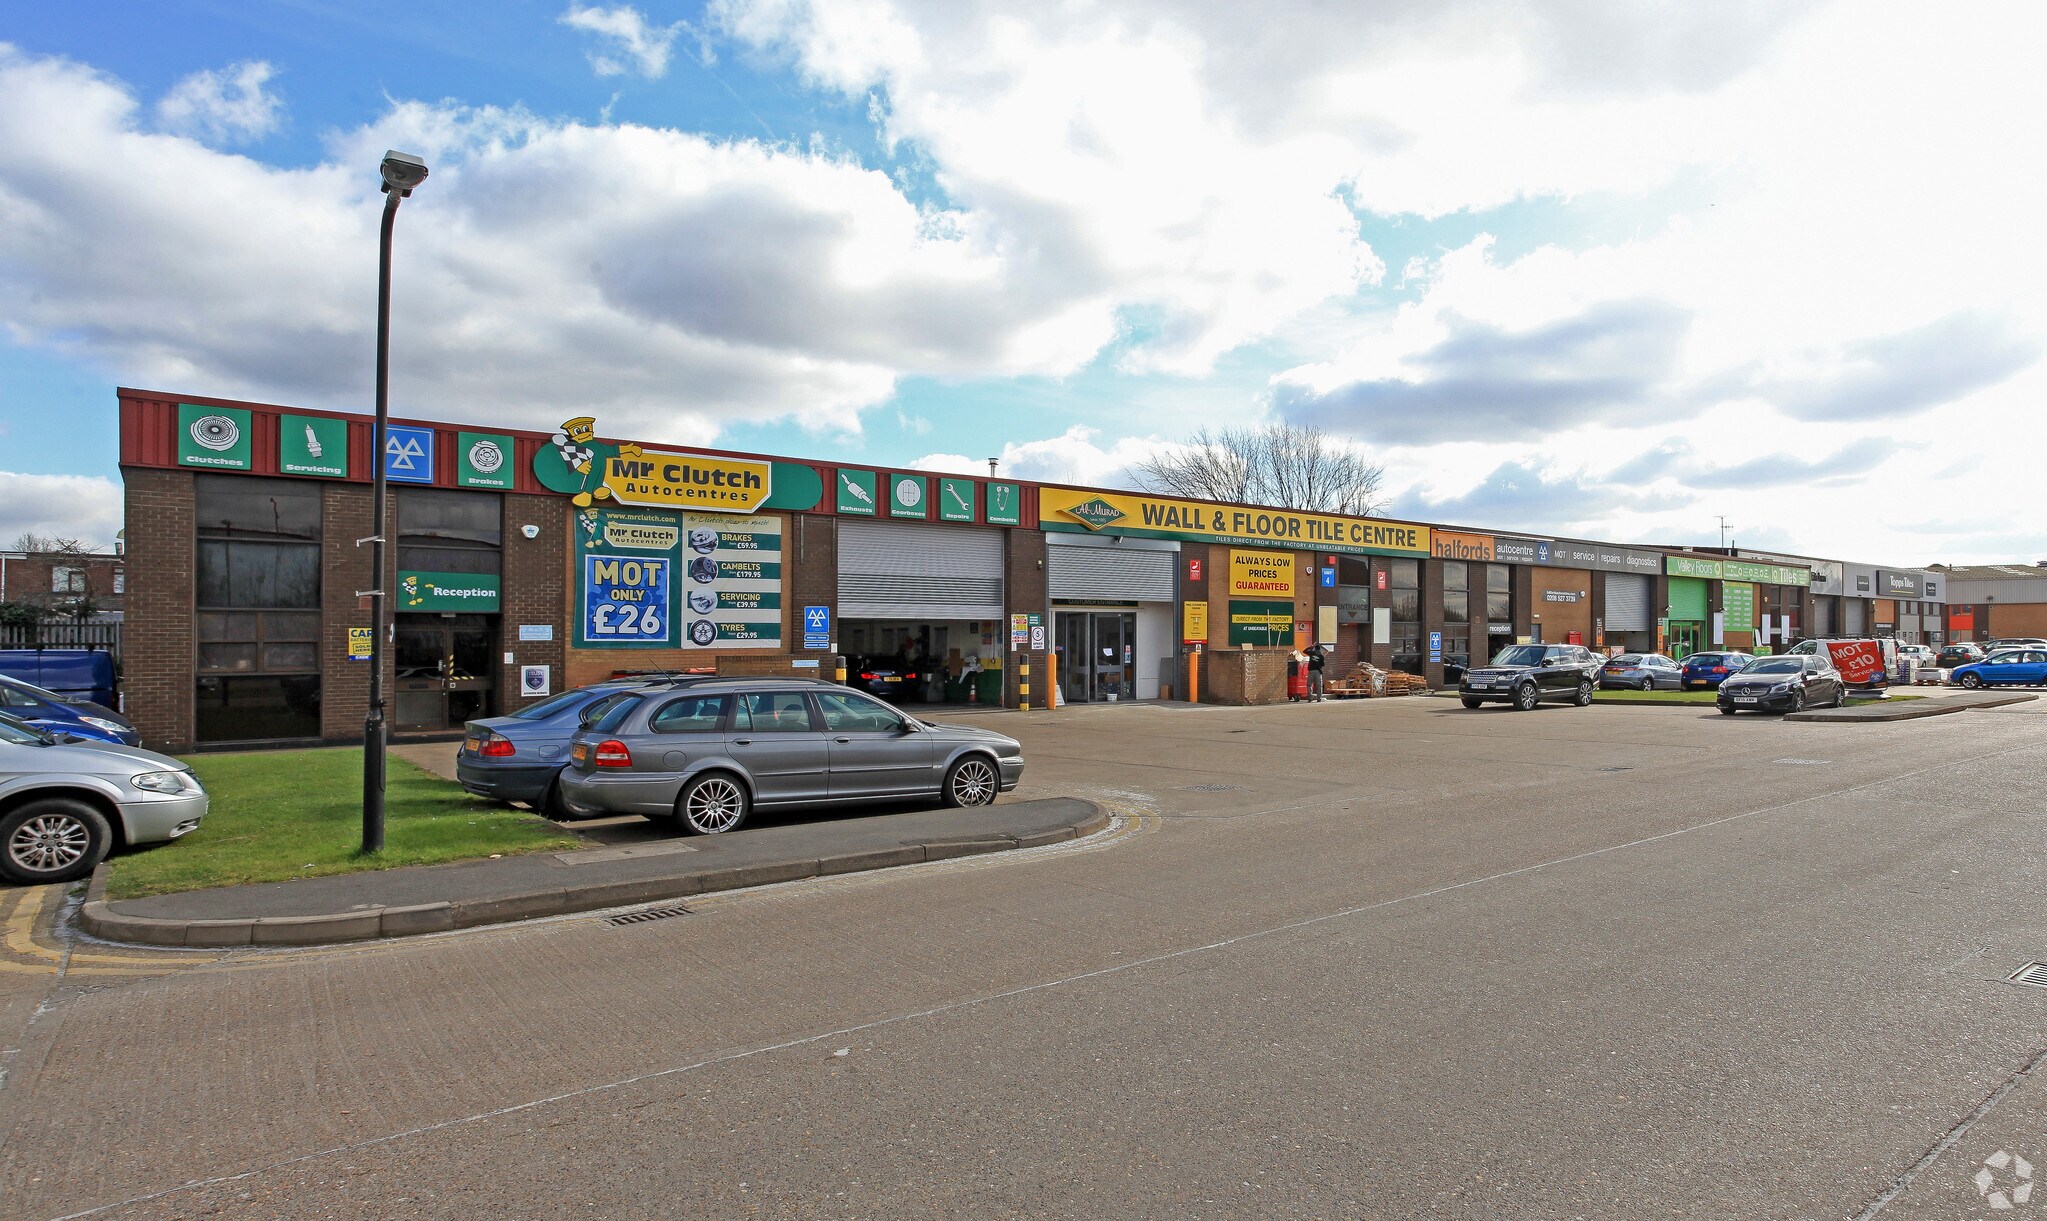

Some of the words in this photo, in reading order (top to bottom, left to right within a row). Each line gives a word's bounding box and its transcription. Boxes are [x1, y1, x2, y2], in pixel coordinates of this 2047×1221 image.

[186, 455, 244, 466] Clutches
[286, 464, 342, 475] Servicing
[612, 460, 654, 479] Mr
[663, 464, 761, 490] Clutch
[468, 477, 504, 486] Brakes
[625, 482, 749, 502] Autocentres
[606, 512, 676, 522] www.mrclutch.com
[1142, 503, 1205, 529] WALL
[1212, 510, 1226, 531] &
[1234, 512, 1300, 538] FLOOR
[1306, 520, 1344, 541] TILE
[1350, 524, 1416, 548] CENTRE
[631, 530, 673, 540] Clutch
[722, 534, 752, 542] BRAKES
[1436, 538, 1490, 560] halfords
[1496, 544, 1534, 556] autocentre
[1236, 556, 1270, 566] ALWAYS
[1272, 558, 1290, 567] LOW
[1554, 550, 1566, 558] MOT
[1573, 551, 1594, 560] service
[1600, 553, 1620, 564] repairs
[1626, 555, 1656, 568] diagnostics
[594, 560, 662, 587] MOT
[1248, 569, 1277, 578] PRICES
[1677, 560, 1694, 574] Valley
[1696, 561, 1712, 574] Floors
[1780, 568, 1796, 584] Tiles
[1890, 576, 1904, 588] Topps
[1904, 577, 1914, 588] Tiles
[433, 586, 496, 599] Reception
[1236, 580, 1290, 592] GUARANTEED
[610, 588, 645, 602] ONLY
[592, 603, 661, 636] £26
[1832, 643, 1862, 660] MOT
[1849, 654, 1874, 670] £10
